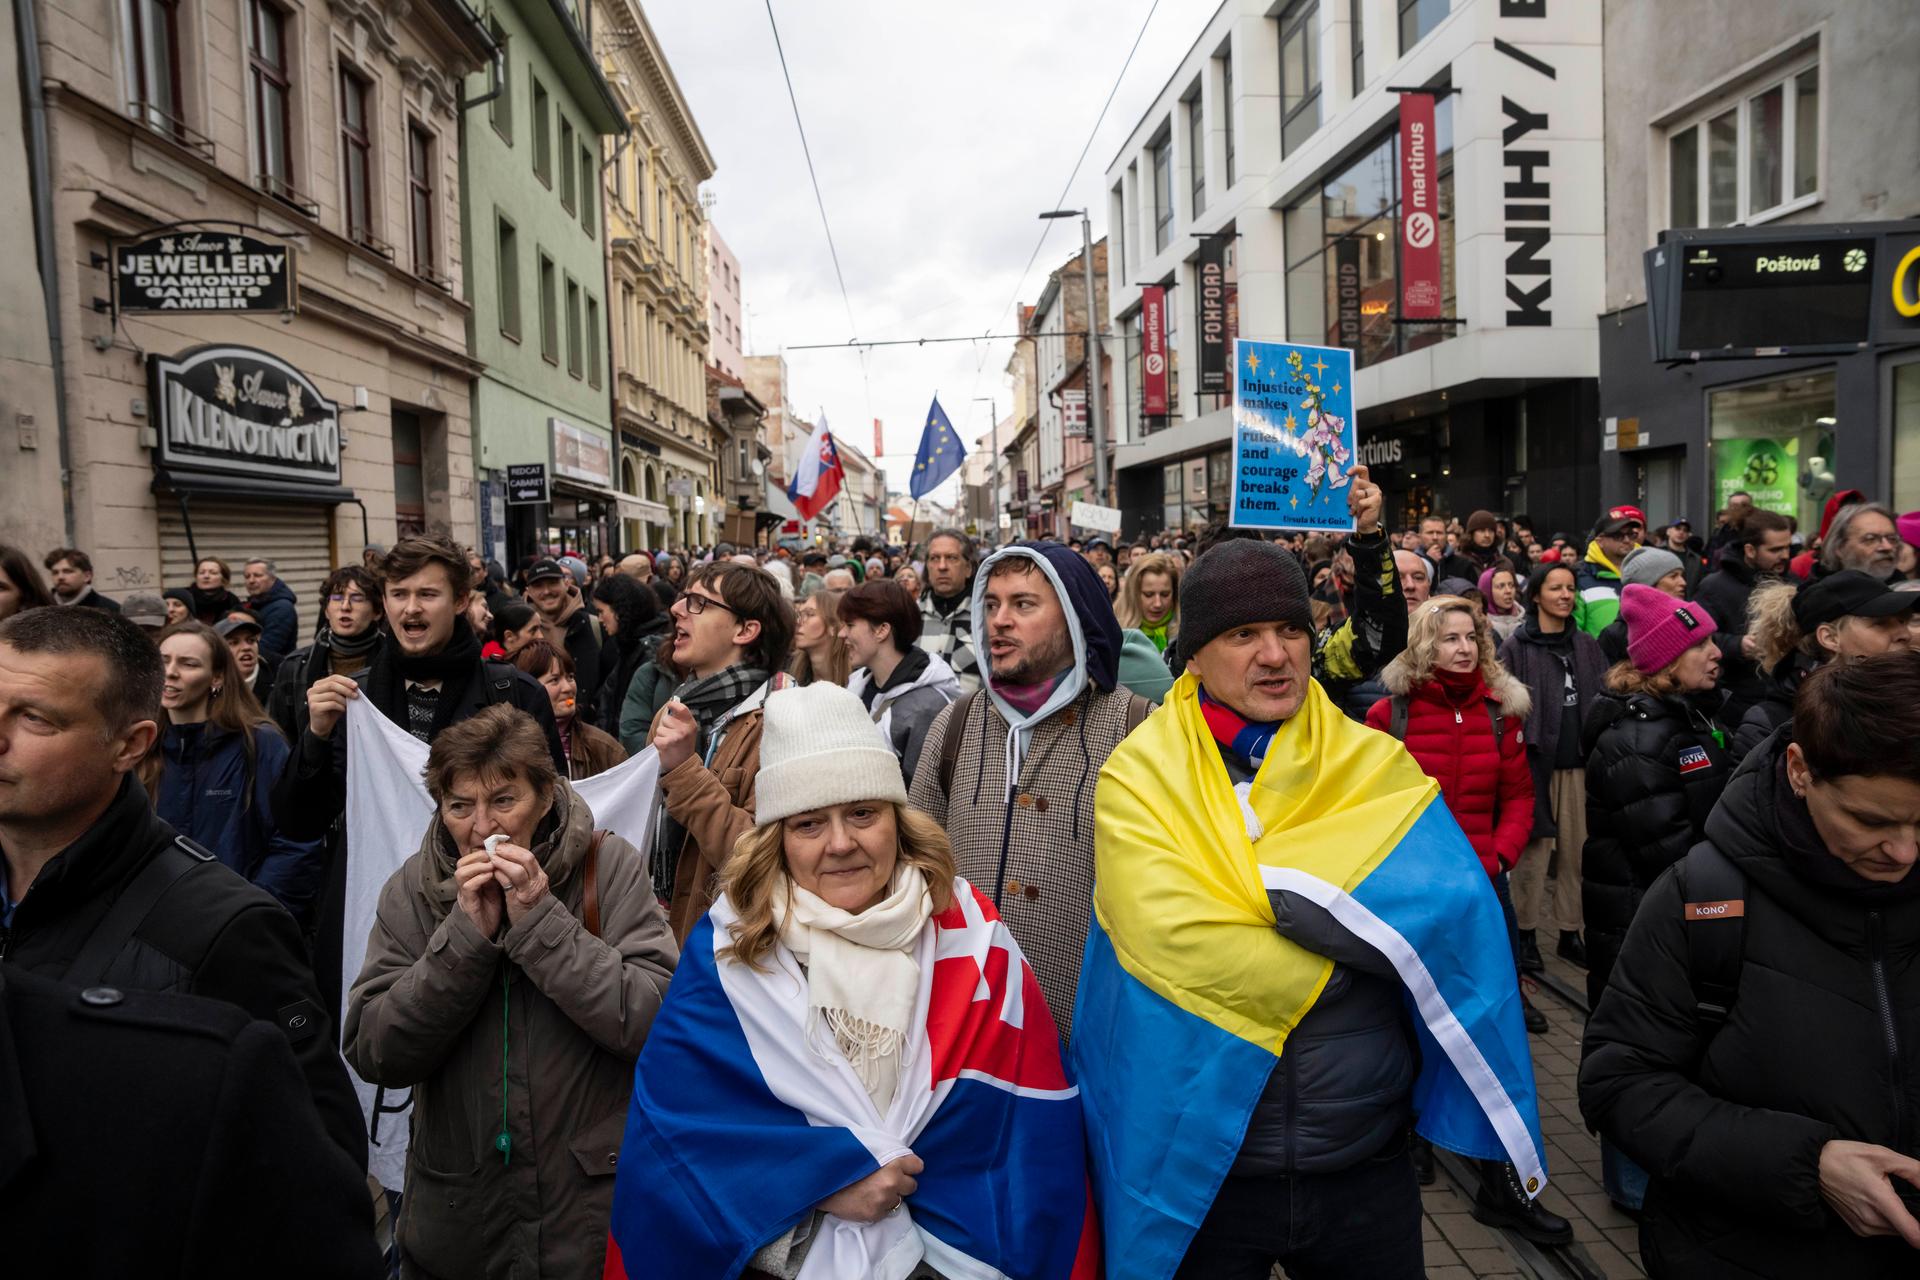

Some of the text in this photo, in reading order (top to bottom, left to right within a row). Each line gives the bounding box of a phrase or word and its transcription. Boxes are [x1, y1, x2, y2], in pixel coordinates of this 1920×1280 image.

[1408, 122, 1426, 207] martinus
[1502, 95, 1552, 327] KNIHY
[178, 234, 224, 251] Amor
[119, 254, 285, 275] JEWELLERY
[1755, 254, 1820, 273] Poštová
[135, 275, 272, 287] DIAMONDS
[146, 287, 262, 298] GARNETS
[160, 298, 248, 309] AMBER
[1149, 303, 1159, 352] martinus
[238, 370, 287, 409] Amor
[1243, 379, 1303, 395] Injustice
[1243, 398, 1288, 411] makes
[168, 379, 338, 465] KLENOTNÍCTVO
[1242, 430, 1279, 443] rules
[1242, 447, 1269, 459] and
[1357, 435, 1402, 465] artinus
[1241, 466, 1298, 482] courage
[509, 478, 544, 488] CABARET
[1241, 480, 1289, 494] breaks
[1240, 497, 1280, 511] them.
[1283, 515, 1347, 525] Ursula K Le Guin
